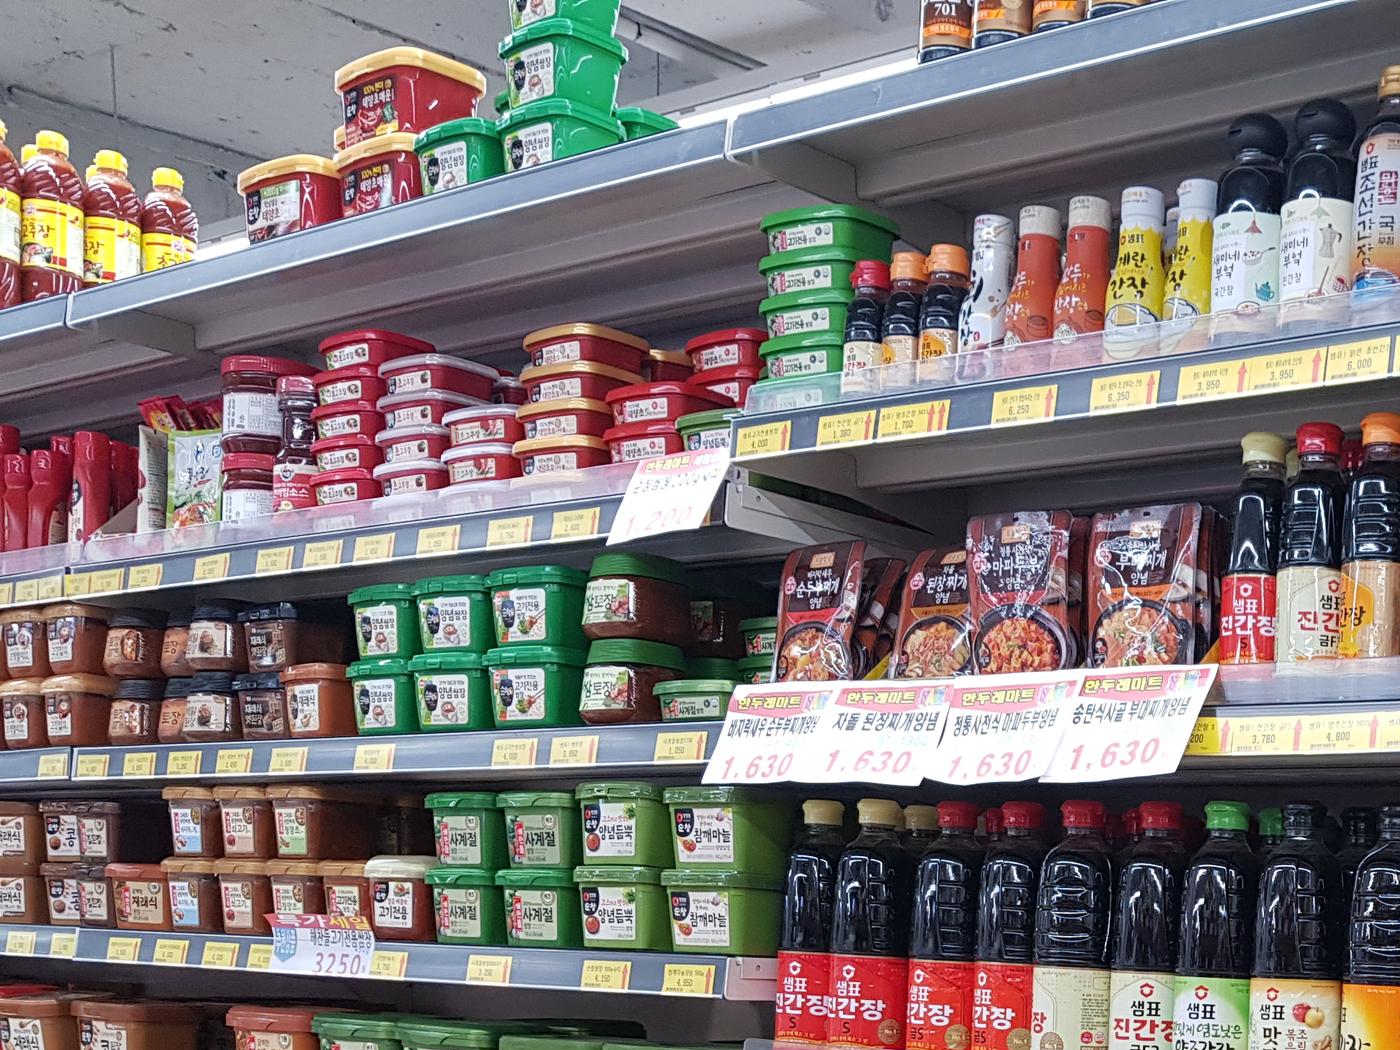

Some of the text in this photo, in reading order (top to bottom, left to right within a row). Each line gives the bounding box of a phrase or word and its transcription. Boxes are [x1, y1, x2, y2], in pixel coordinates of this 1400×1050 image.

[1127, 233, 1145, 245] 샘표
[1346, 357, 1372, 371] 6,000
[1108, 390, 1130, 403] 6,350
[1233, 599, 1259, 614] 샘표
[1084, 675, 1163, 696] 한두레마트
[1326, 731, 1351, 742] 4,800
[525, 830, 556, 847] 사계절
[837, 980, 861, 997] 샘표
[1130, 1000, 1161, 1017] 샘표
[1187, 1003, 1216, 1020] 샘표
[1259, 1003, 1286, 1021] 샘표
